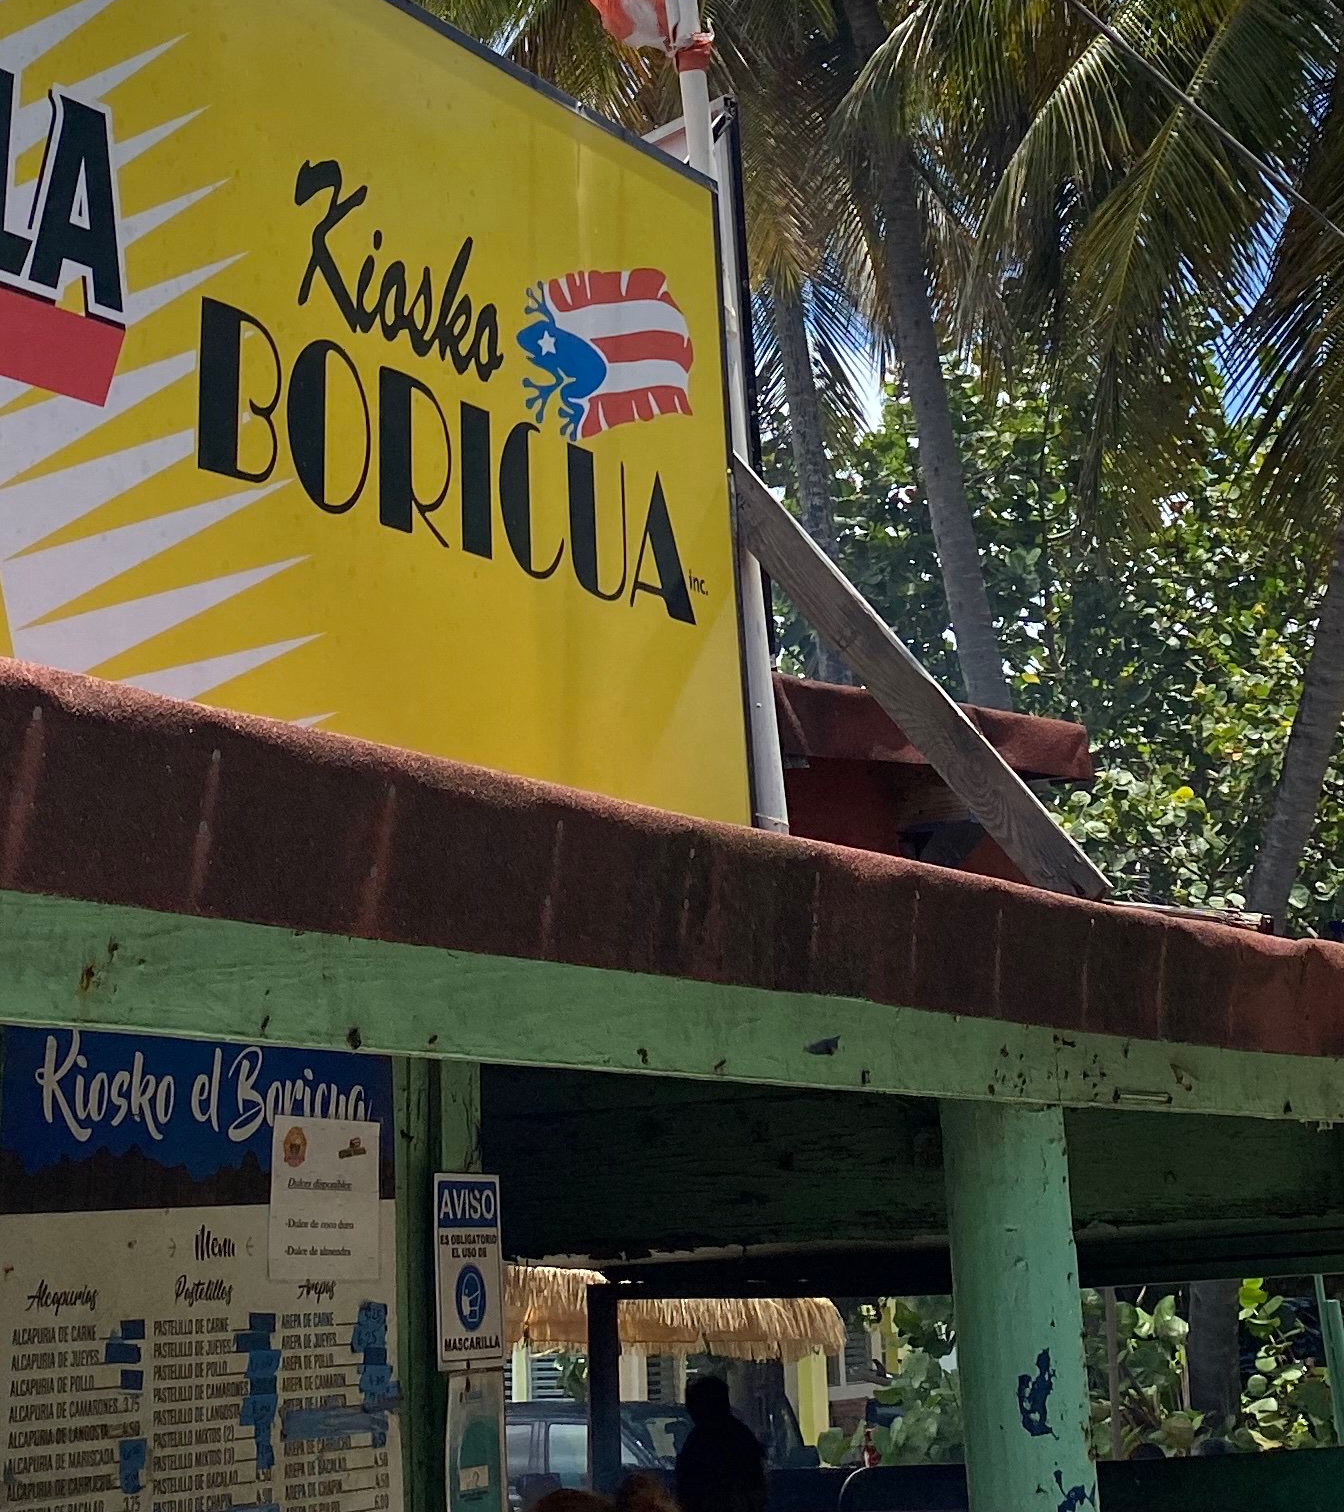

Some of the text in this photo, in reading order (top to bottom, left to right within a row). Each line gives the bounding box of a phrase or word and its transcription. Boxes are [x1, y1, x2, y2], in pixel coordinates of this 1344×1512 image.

[295, 159, 504, 382] Kiosko
[197, 295, 696, 626] BORICUA
[35, 1029, 175, 1142] Kiosko
[191, 1047, 223, 1132] el
[440, 1189, 495, 1219] AVISO
[310, 1219, 319, 1228] de
[195, 1224, 236, 1261] Menu
[440, 1233, 497, 1245] ES OBLIGATORIO
[309, 1245, 318, 1255] de
[452, 1247, 487, 1258] EL USO DE
[154, 1316, 229, 1336] PASTELILLO DE CARNE
[303, 1313, 312, 1328] DE
[12, 1324, 96, 1345] ALCAPURIA DE CARNE
[303, 1334, 312, 1349] DE
[444, 1335, 501, 1351] MASCARILLA
[153, 1342, 194, 1359] PASTELILLO
[195, 1340, 204, 1356] DE
[11, 1349, 100, 1371] ALCAPURIA DE JUEYES
[153, 1364, 194, 1380] PASTELILLO
[195, 1363, 204, 1378] DE
[10, 1374, 94, 1397] ALCAPURIA DE POLLO
[153, 1386, 193, 1404] PASTELILLO
[195, 1385, 204, 1401] DE
[9, 1402, 54, 1423] ALCAPURIA
[55, 1401, 67, 1418] DE
[153, 1408, 194, 1427] PASTELILLO
[56, 1427, 67, 1444] DE
[153, 1430, 193, 1449] PASTELILLO
[8, 1455, 53, 1476] ALCAPURIA
[55, 1453, 67, 1470] DE
[153, 1453, 193, 1472] PASTELILLO
[153, 1475, 193, 1495] PASTELILLO
